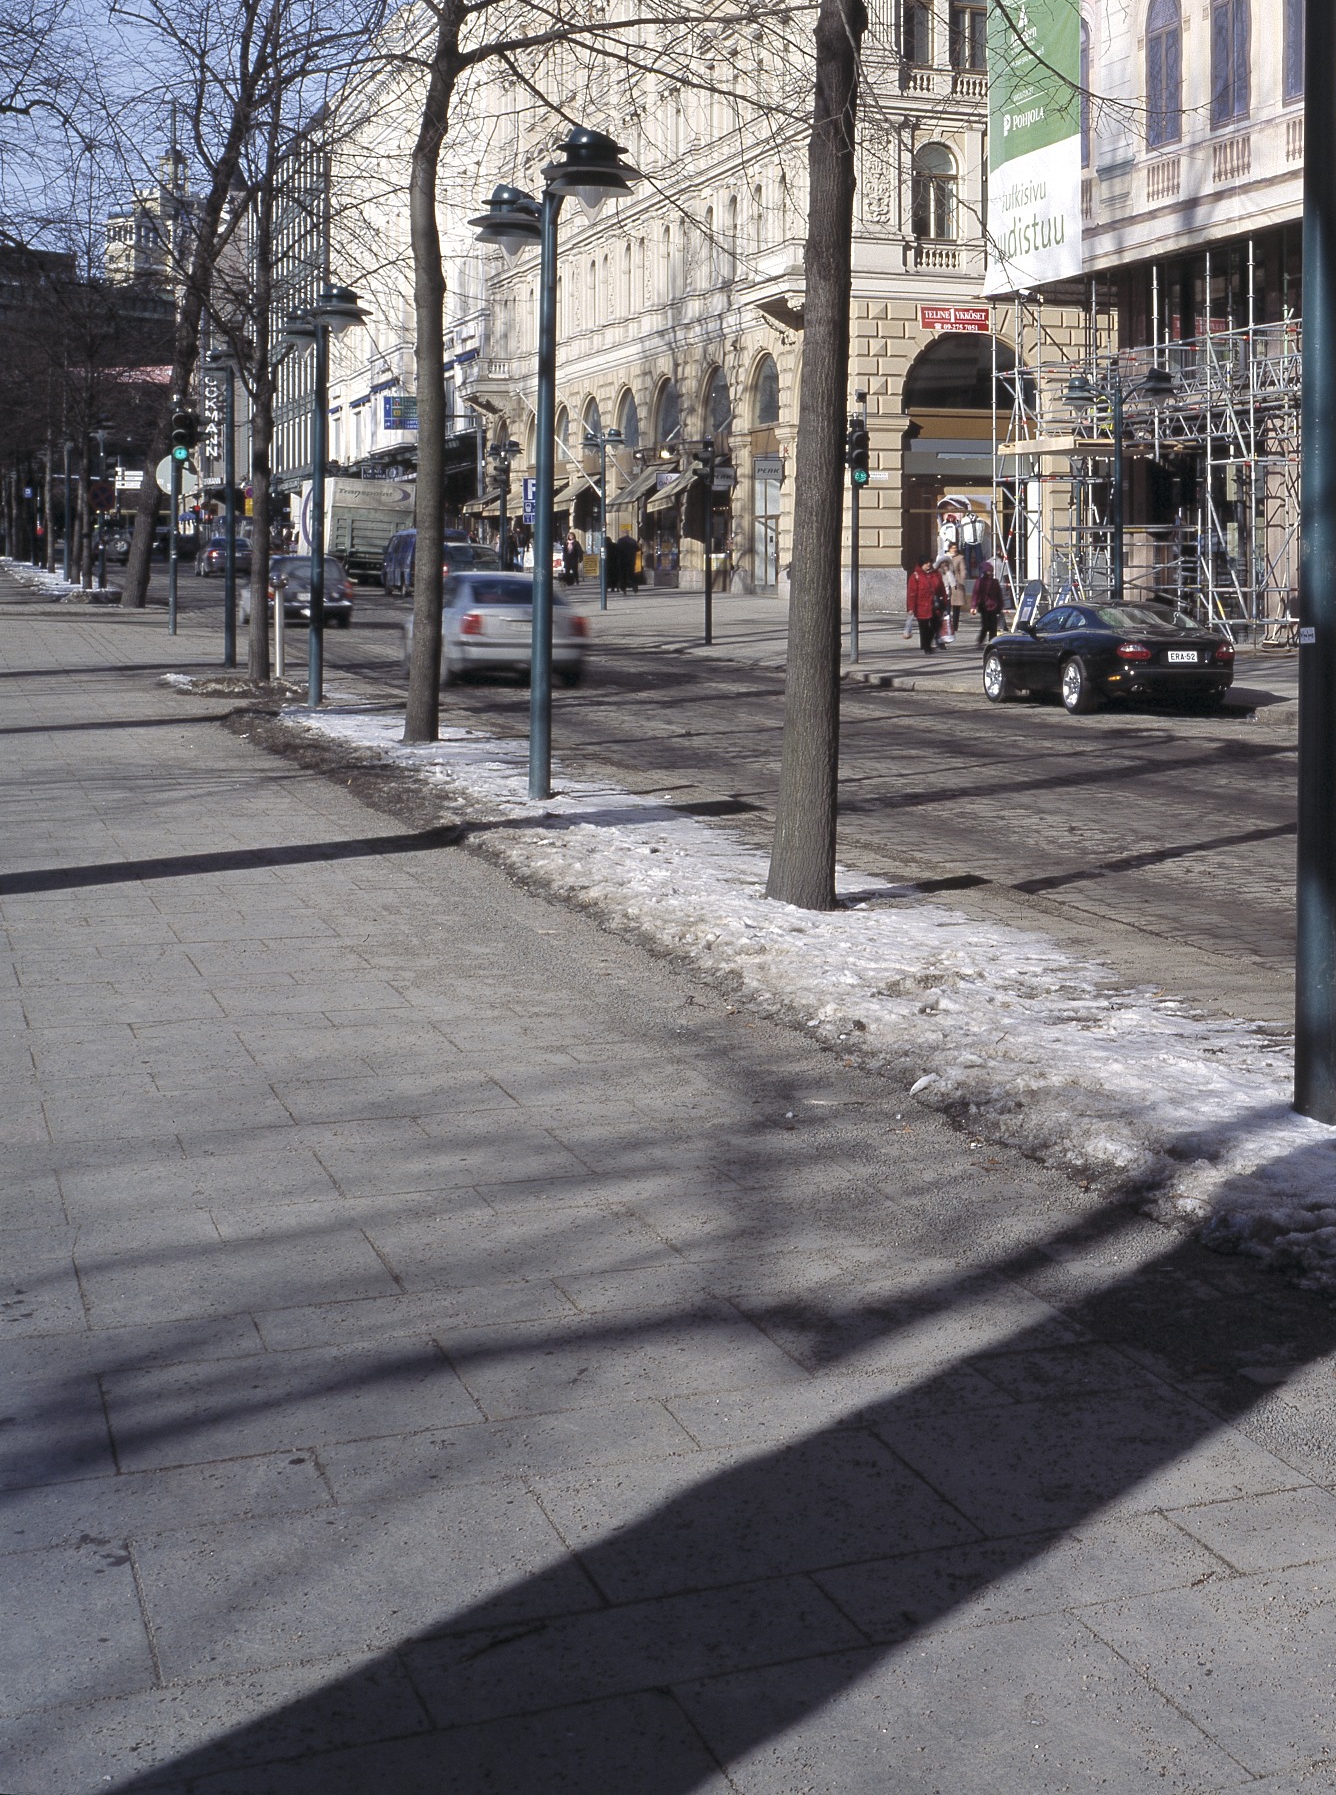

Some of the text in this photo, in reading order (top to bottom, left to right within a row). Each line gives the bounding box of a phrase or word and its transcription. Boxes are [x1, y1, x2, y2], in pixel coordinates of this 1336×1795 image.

[1012, 106, 1044, 130] POHJOLA
[924, 310, 950, 319] TELINE
[956, 310, 986, 320] YKKÖSET
[204, 350, 219, 458] SOCKMANN
[1170, 652, 1197, 661] ERA-52
